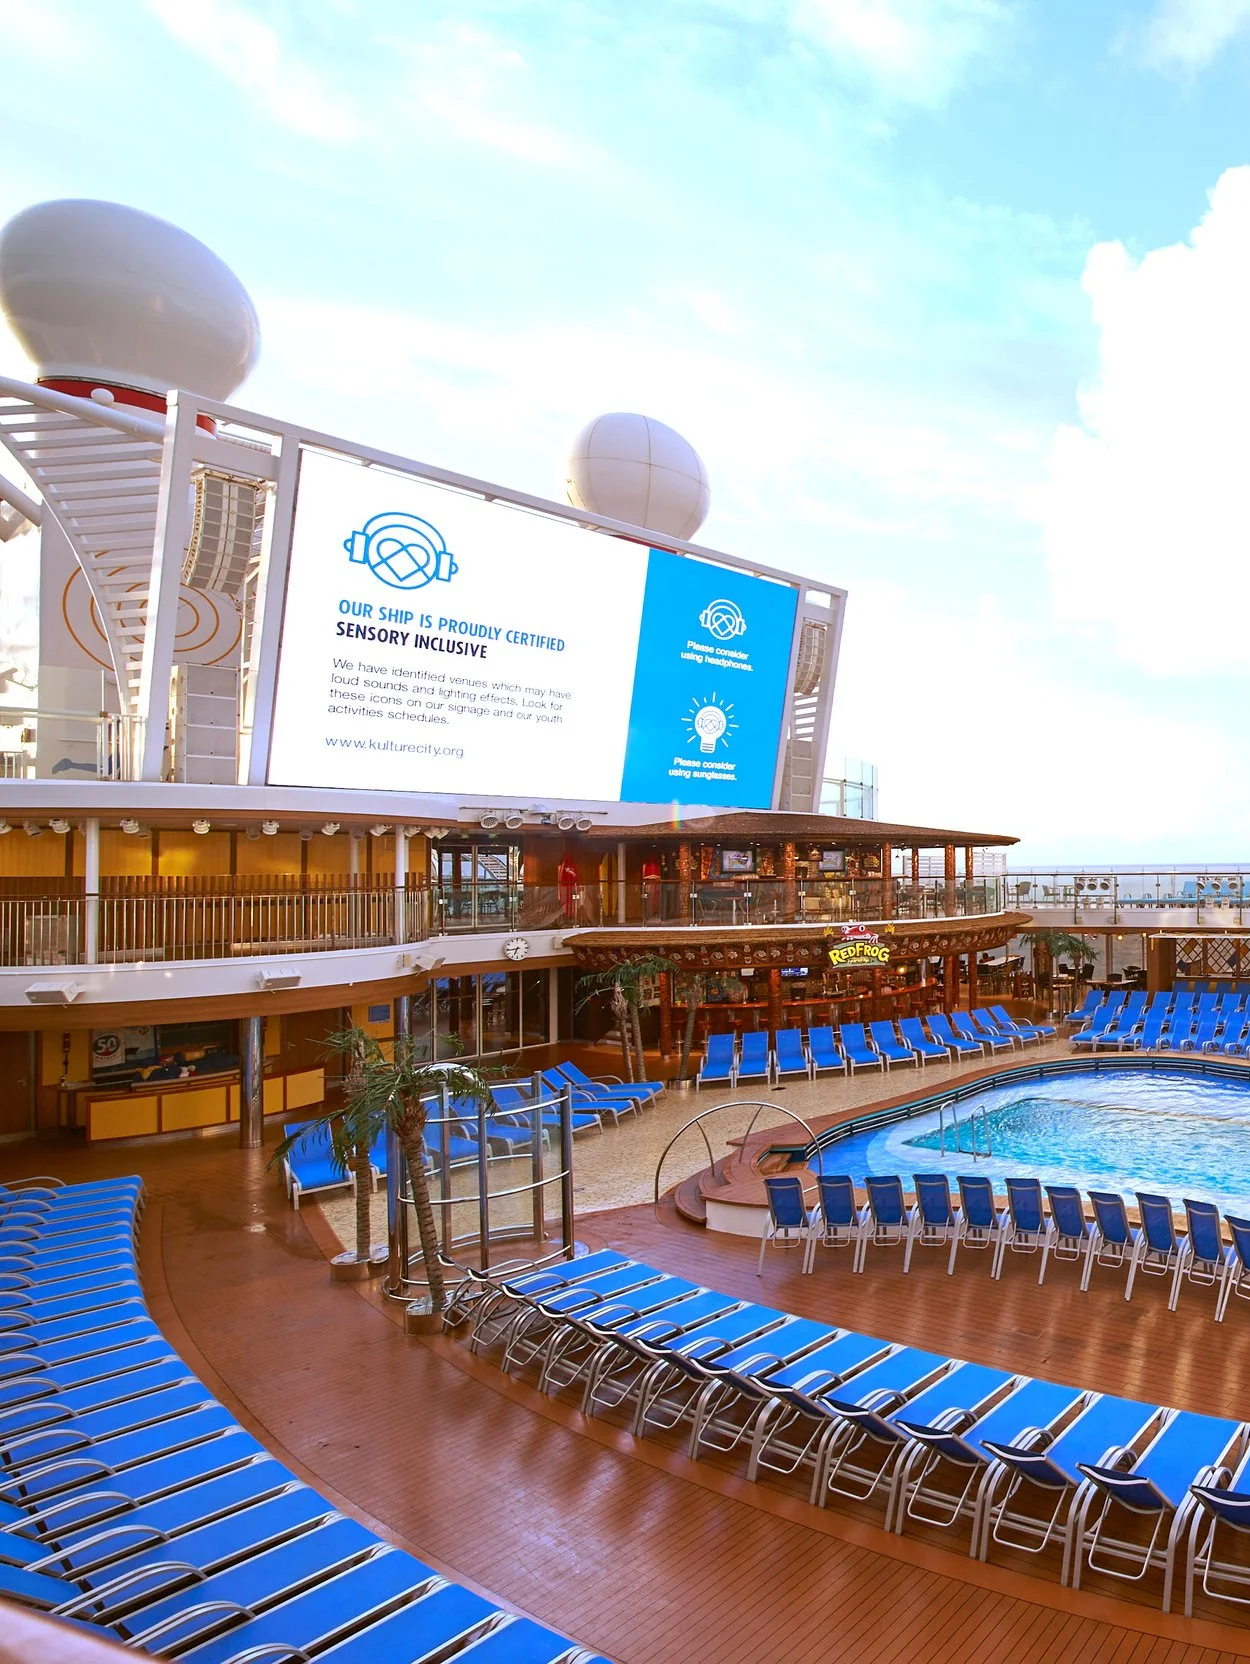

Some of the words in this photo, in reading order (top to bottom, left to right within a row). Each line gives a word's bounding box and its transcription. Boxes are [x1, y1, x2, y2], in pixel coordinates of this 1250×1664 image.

[339, 599, 373, 619] OUR
[378, 606, 414, 625] SHIP
[419, 613, 433, 629] IS
[438, 617, 502, 641] PROUDLY
[505, 630, 565, 652] CERTIFIED
[336, 621, 410, 646] SENSORY
[414, 634, 488, 659] INCLUSIVE
[687, 640, 714, 653] Please
[715, 648, 749, 660] consider
[680, 652, 703, 664] using
[705, 655, 754, 672] headphones.
[333, 657, 354, 671] We
[358, 661, 388, 675] have
[391, 666, 446, 683] identified
[449, 676, 488, 690] venues
[491, 681, 522, 694] which
[524, 686, 547, 699] may
[549, 688, 572, 701] have
[331, 673, 360, 686] loud
[363, 679, 409, 692] sounds
[412, 685, 435, 696] and
[439, 687, 477, 703] lighting
[479, 692, 518, 706] effects.
[522, 697, 547, 710] Look
[550, 701, 564, 711] for
[327, 704, 384, 718] activities
[387, 710, 450, 725] schedules.
[330, 688, 366, 702] these
[369, 692, 403, 706] icons
[406, 698, 422, 708] on
[425, 700, 445, 710] our
[447, 702, 490, 717] signage
[493, 708, 514, 718] and
[516, 711, 533, 721] our
[535, 713, 563, 724] youth
[325, 737, 464, 759] www.kulturecity.org
[668, 768, 692, 779] using
[692, 771, 738, 781] sunglasses.
[673, 757, 701, 768] Please
[702, 761, 737, 771] consider
